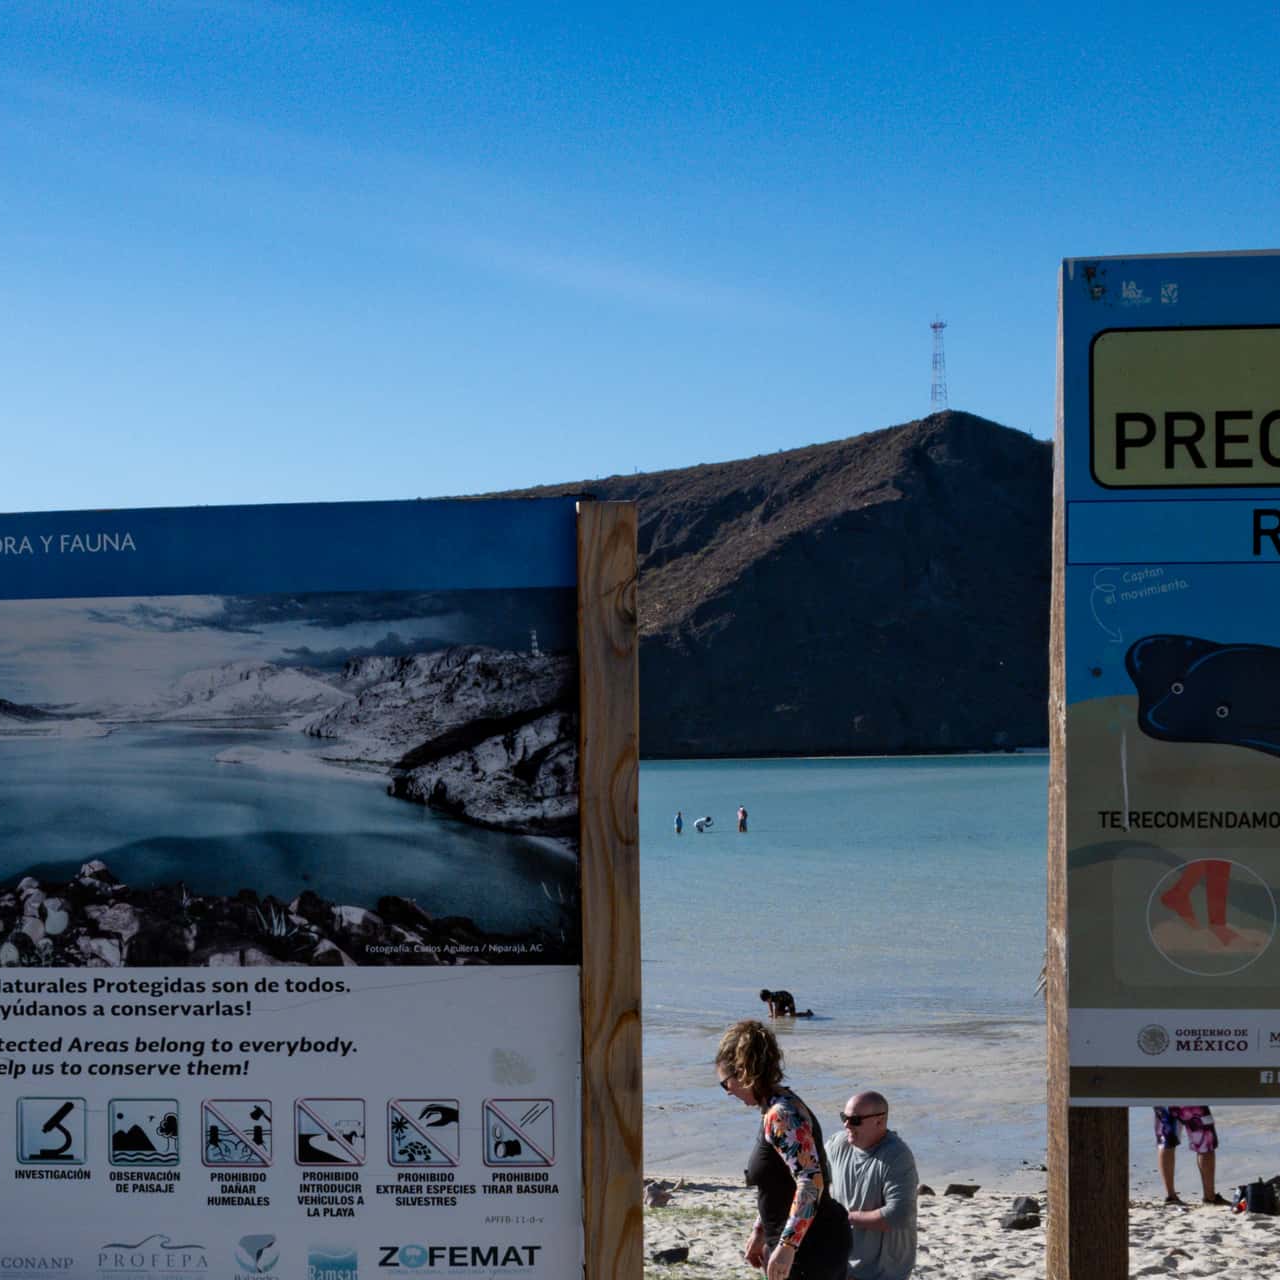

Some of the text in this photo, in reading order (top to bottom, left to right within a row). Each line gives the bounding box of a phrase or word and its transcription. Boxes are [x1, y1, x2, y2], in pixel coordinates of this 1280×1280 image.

[39, 535, 54, 554] Y
[60, 531, 137, 553] FAUNA
[1097, 810, 1123, 829] TE
[480, 943, 487, 953] /
[93, 976, 206, 998] Protegidas
[212, 981, 248, 993] son
[254, 977, 279, 993] de
[284, 976, 351, 993] todos.
[93, 1004, 105, 1017] a
[110, 1000, 251, 1017] conservarlas!
[1175, 1028, 1249, 1039] GOBIERNO DE
[67, 1037, 129, 1053] Areas
[135, 1036, 205, 1057] belong
[211, 1038, 233, 1053] to
[239, 1036, 357, 1057] everybody.
[1176, 1037, 1249, 1052] MÉXICO
[31, 1063, 55, 1076] us
[60, 1061, 82, 1076] to
[87, 1063, 181, 1076] conserve
[187, 1059, 249, 1076] them!
[14, 1167, 91, 1180] INVESTIGACIÓN
[109, 1170, 181, 1182] OBSERVACIÓN
[210, 1172, 266, 1182] PROHIBIDO
[302, 1171, 359, 1182] PROHIBIDO
[397, 1172, 455, 1182] PROHIBIDO
[492, 1172, 549, 1182] PROHIBIDO
[115, 1183, 175, 1194] DE PAISAJE
[220, 1182, 257, 1194] DAÑAR
[299, 1183, 362, 1194] INTRODUCIR
[376, 1184, 476, 1194] EXTRAER ESPECIES
[482, 1184, 559, 1194] TIRAR BASURA
[207, 1196, 270, 1206] HUMEDALES
[297, 1193, 365, 1206] VEHÍCULOS A
[395, 1196, 457, 1207] SILVESTRES
[306, 1207, 355, 1217] LA PLAYA
[0, 1256, 74, 1270] CONANP
[97, 1252, 208, 1268] PROFEPA
